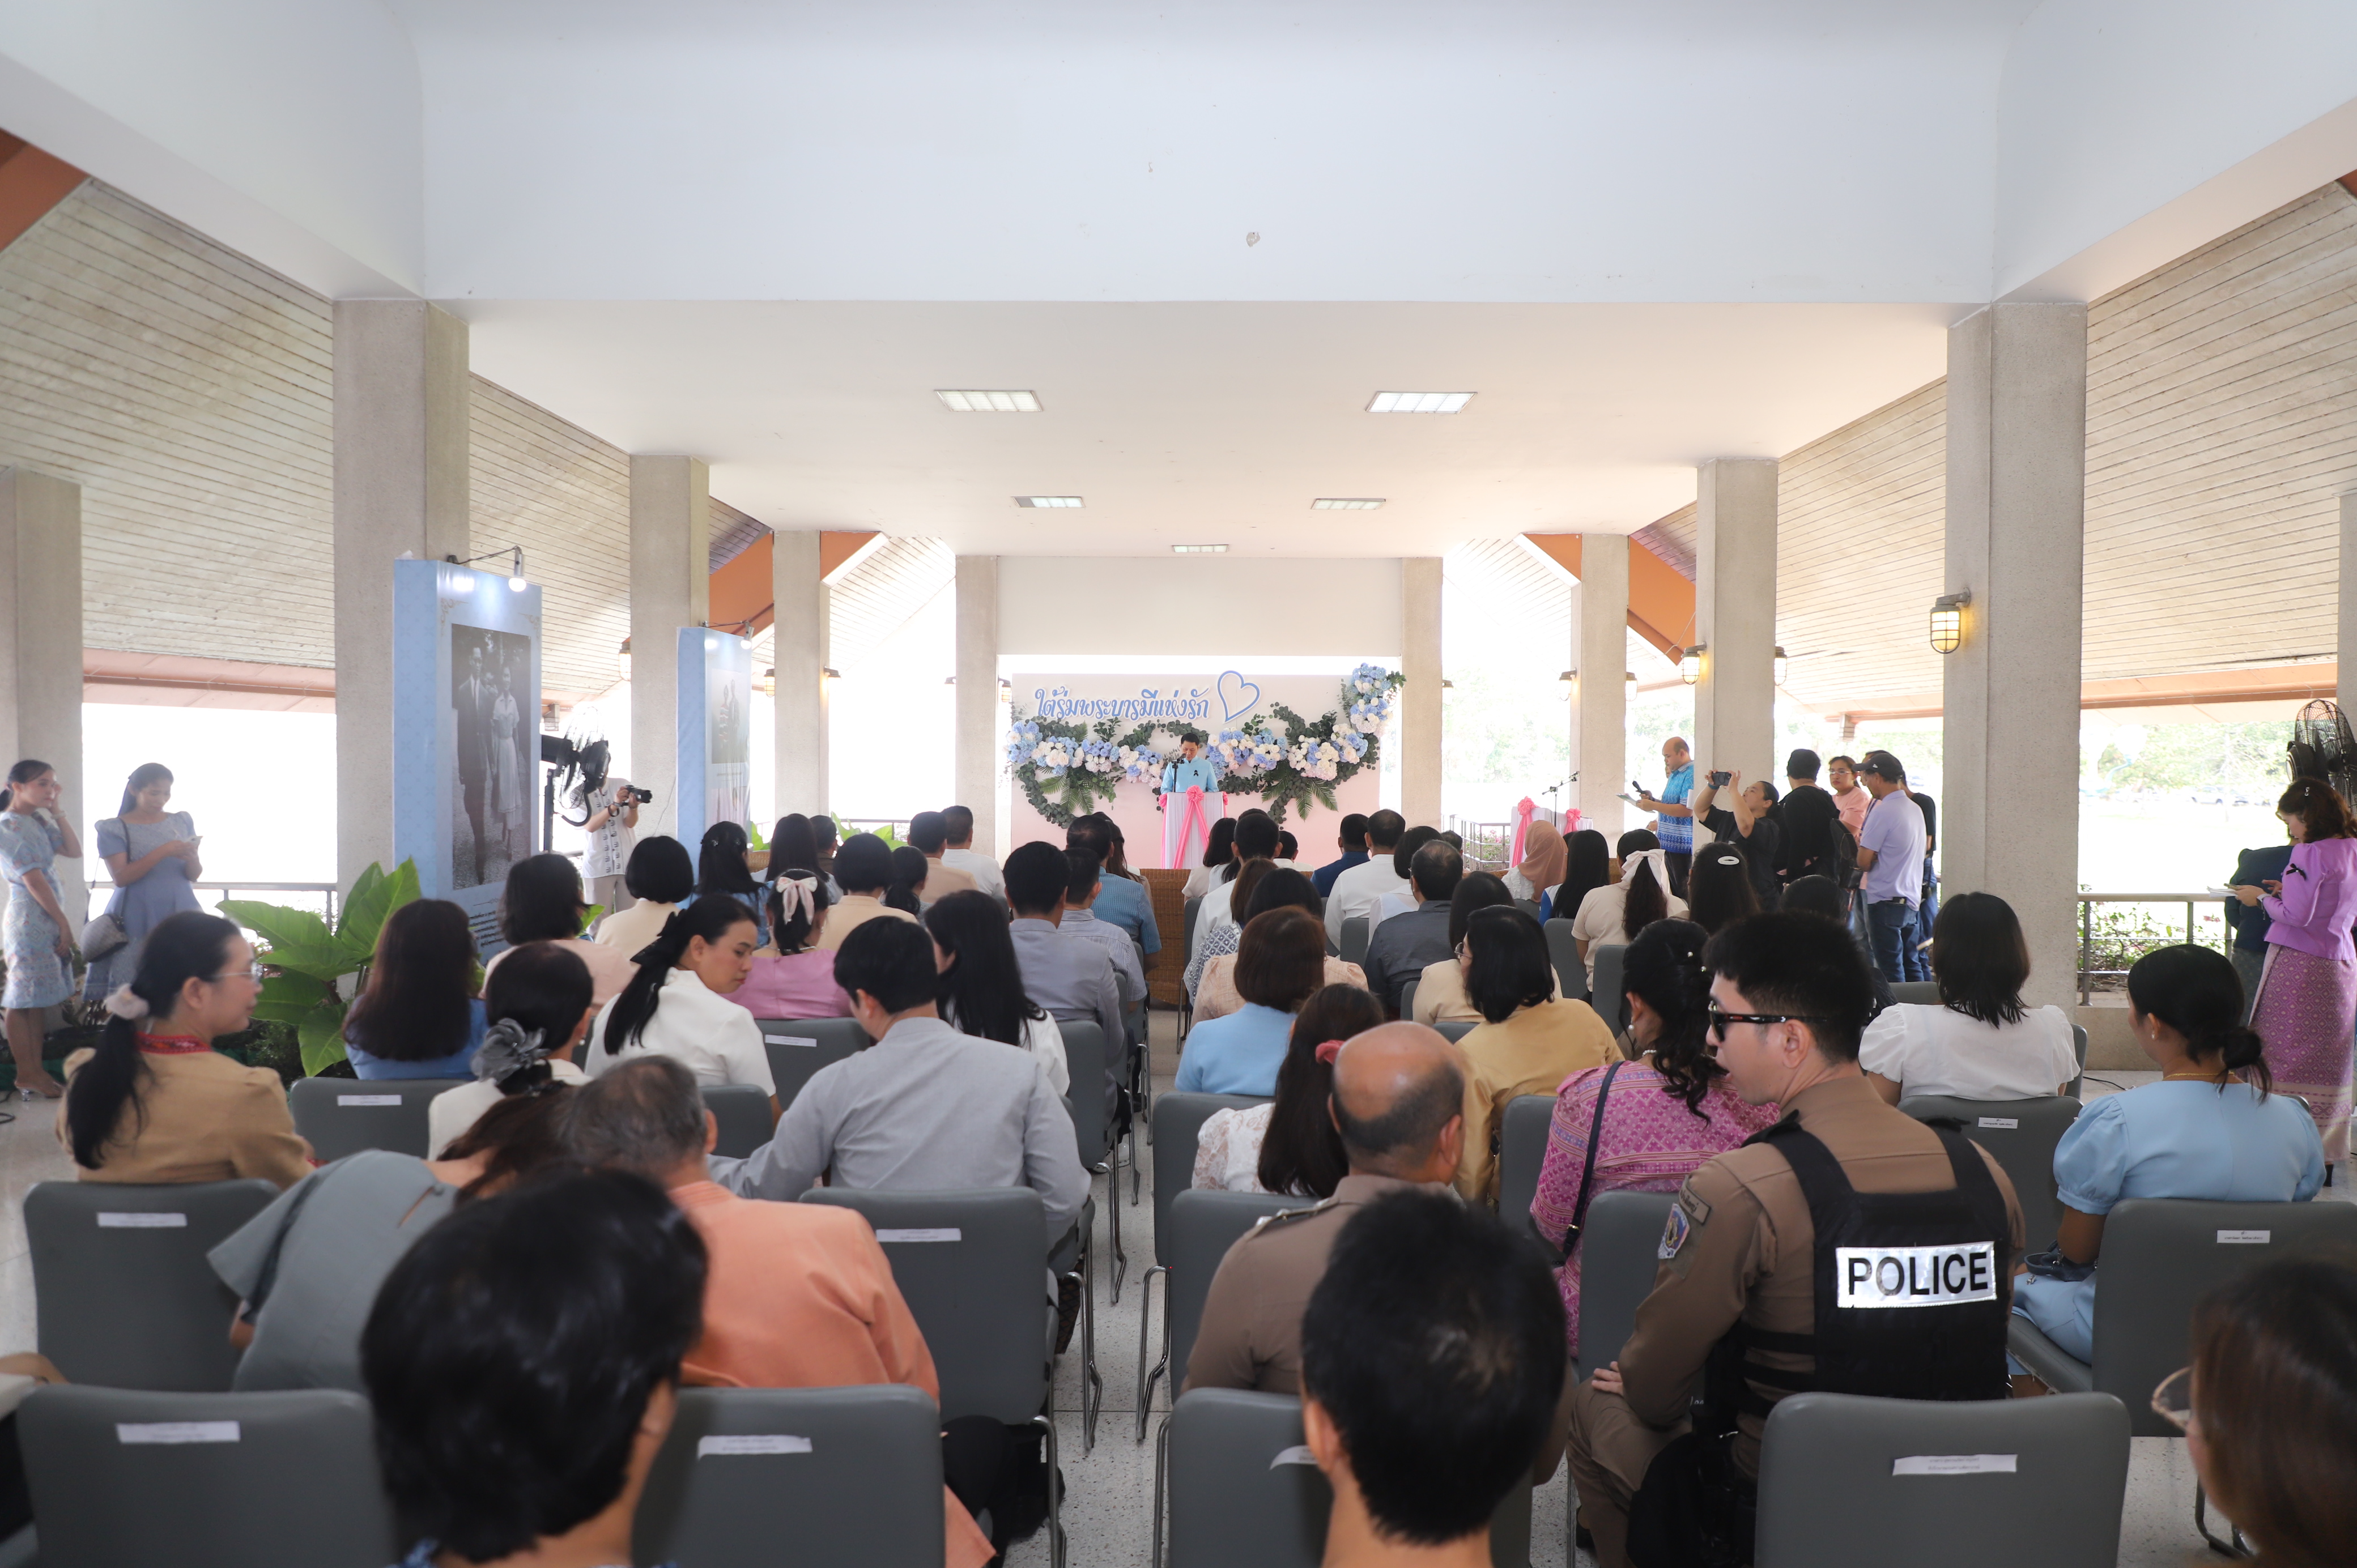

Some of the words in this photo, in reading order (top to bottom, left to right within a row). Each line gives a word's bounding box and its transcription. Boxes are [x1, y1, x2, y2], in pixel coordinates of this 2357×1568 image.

[1035, 686, 1209, 721] ใต้ร่มพระบารมีแห่งรัก
[1848, 1252, 1988, 1296] POLICE
